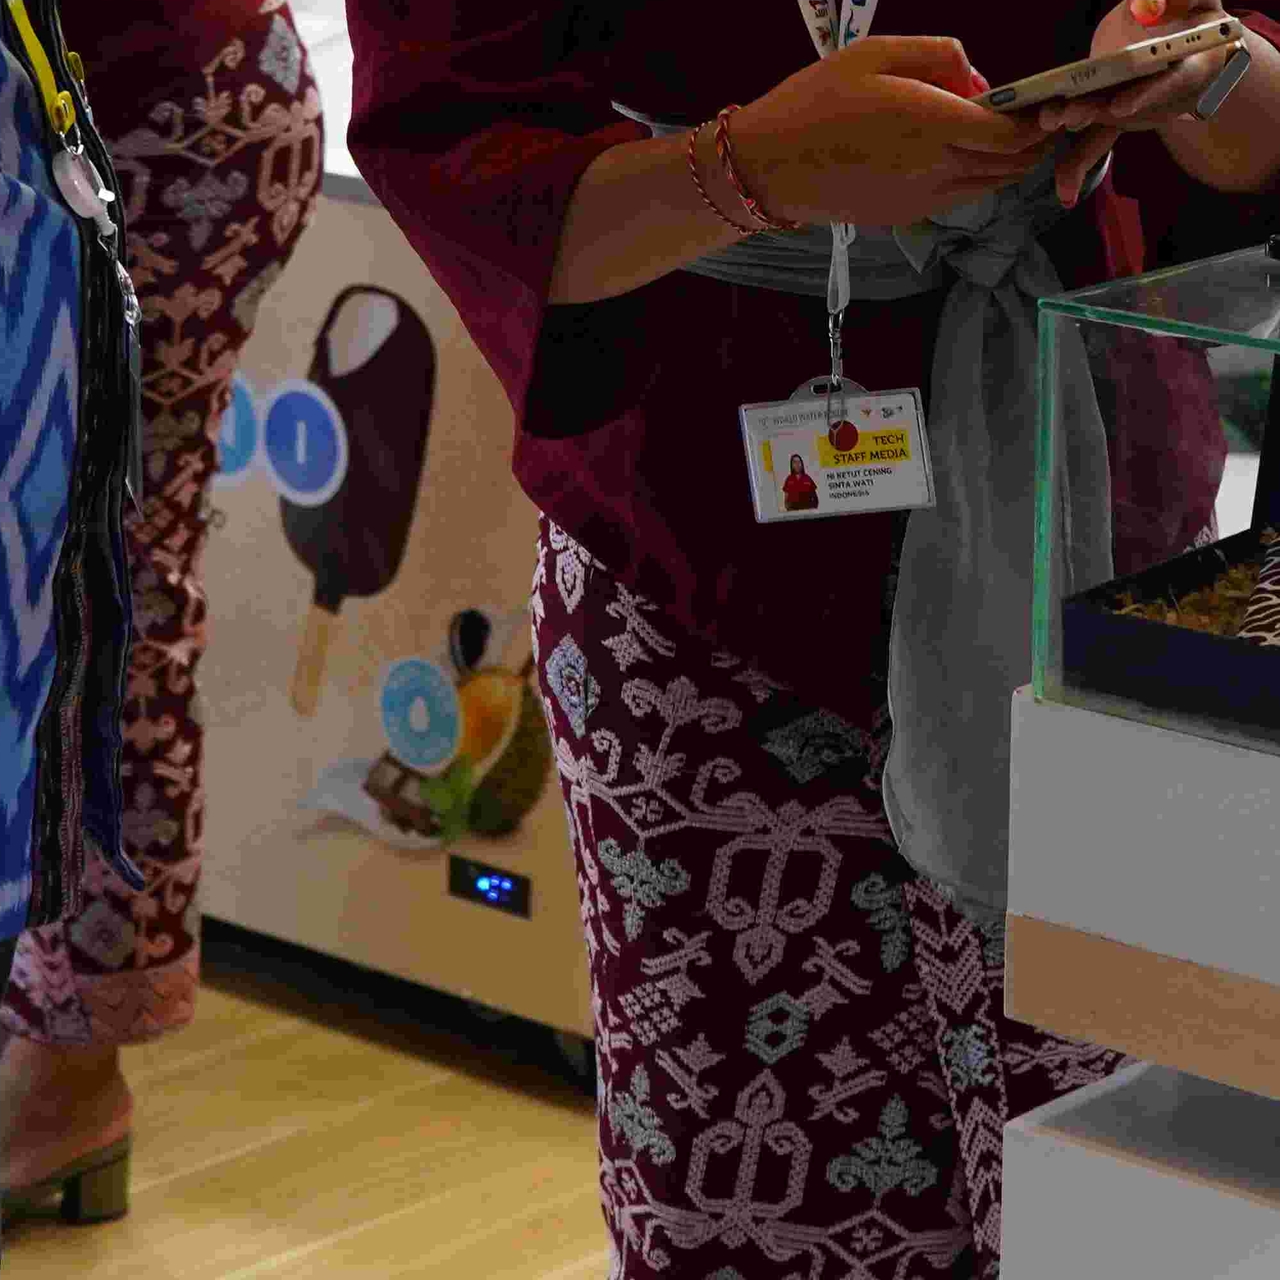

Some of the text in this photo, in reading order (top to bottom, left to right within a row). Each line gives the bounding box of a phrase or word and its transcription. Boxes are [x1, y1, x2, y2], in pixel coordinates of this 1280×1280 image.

[873, 433, 904, 446] TECH
[834, 448, 907, 465] STAFF MEDIA
